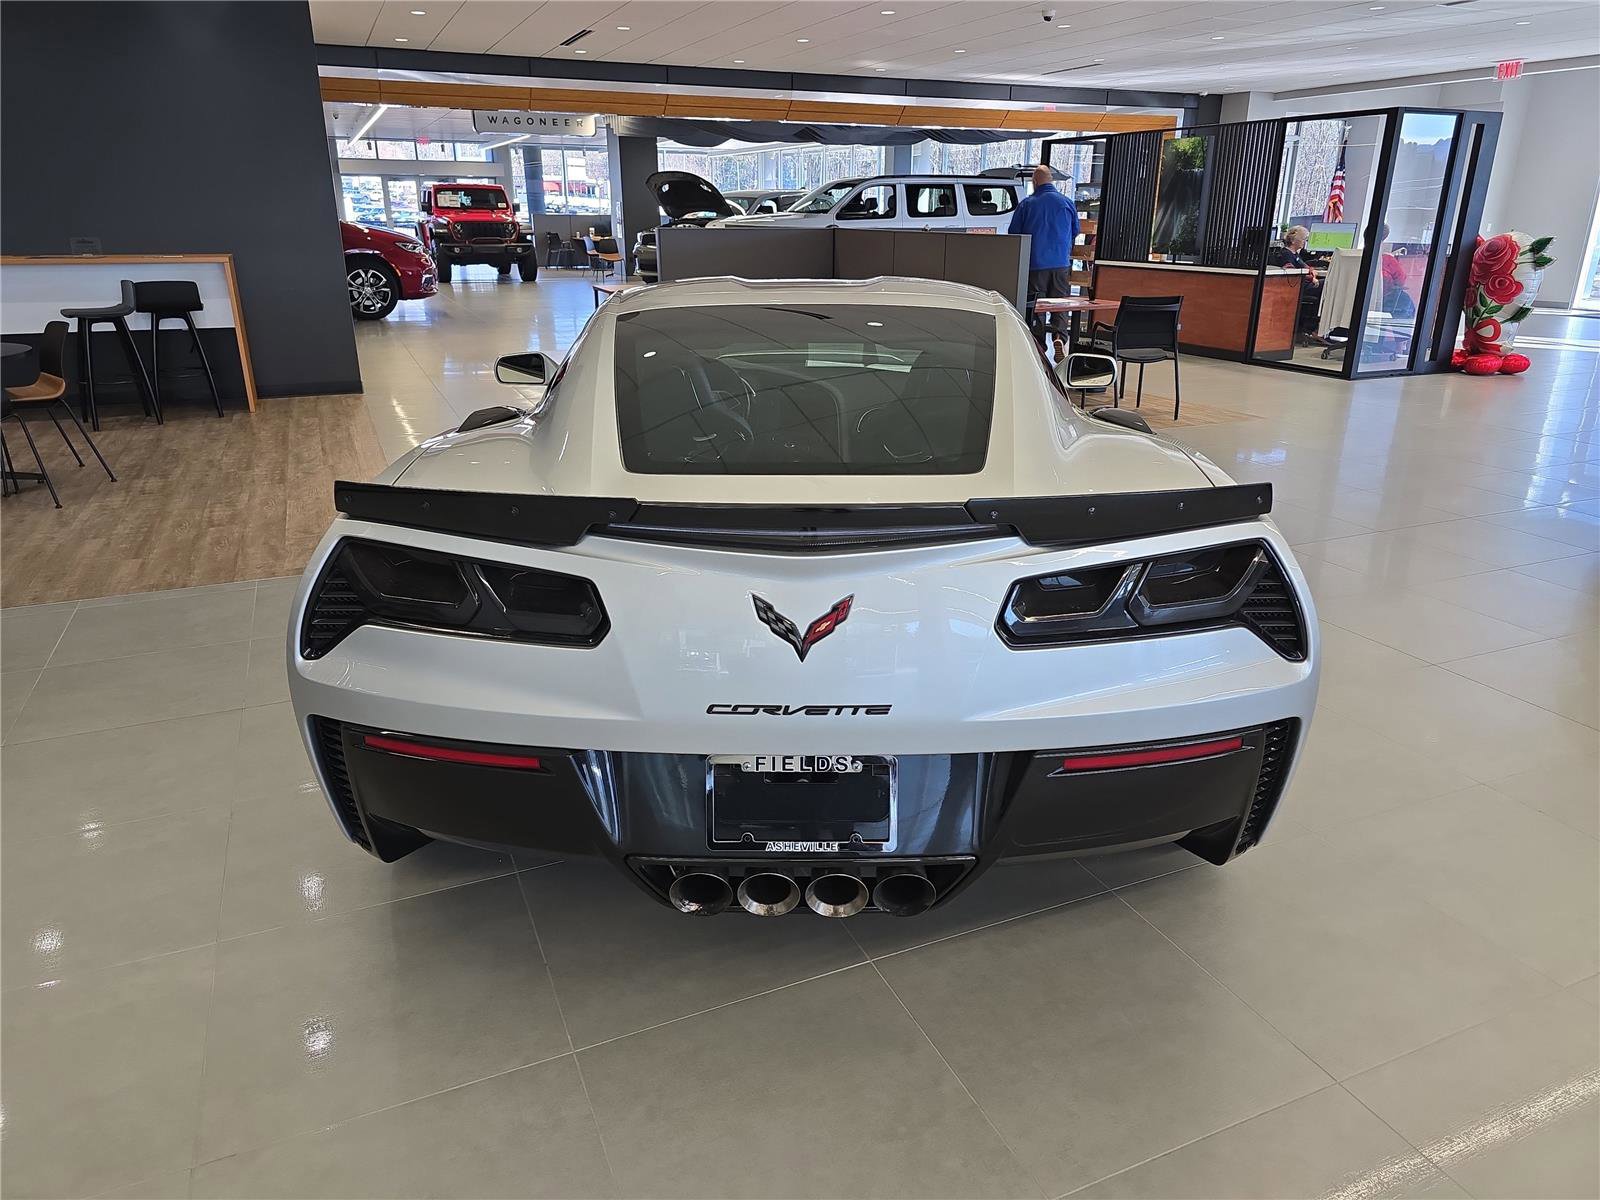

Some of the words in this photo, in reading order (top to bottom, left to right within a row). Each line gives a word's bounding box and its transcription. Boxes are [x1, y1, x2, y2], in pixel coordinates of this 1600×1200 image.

[1498, 61, 1521, 79] EXIT
[487, 115, 584, 128] WAGONEER
[705, 703, 893, 716] CORVETTE
[755, 755, 850, 773] FIELDS
[765, 841, 839, 852] ASHEVILLE
